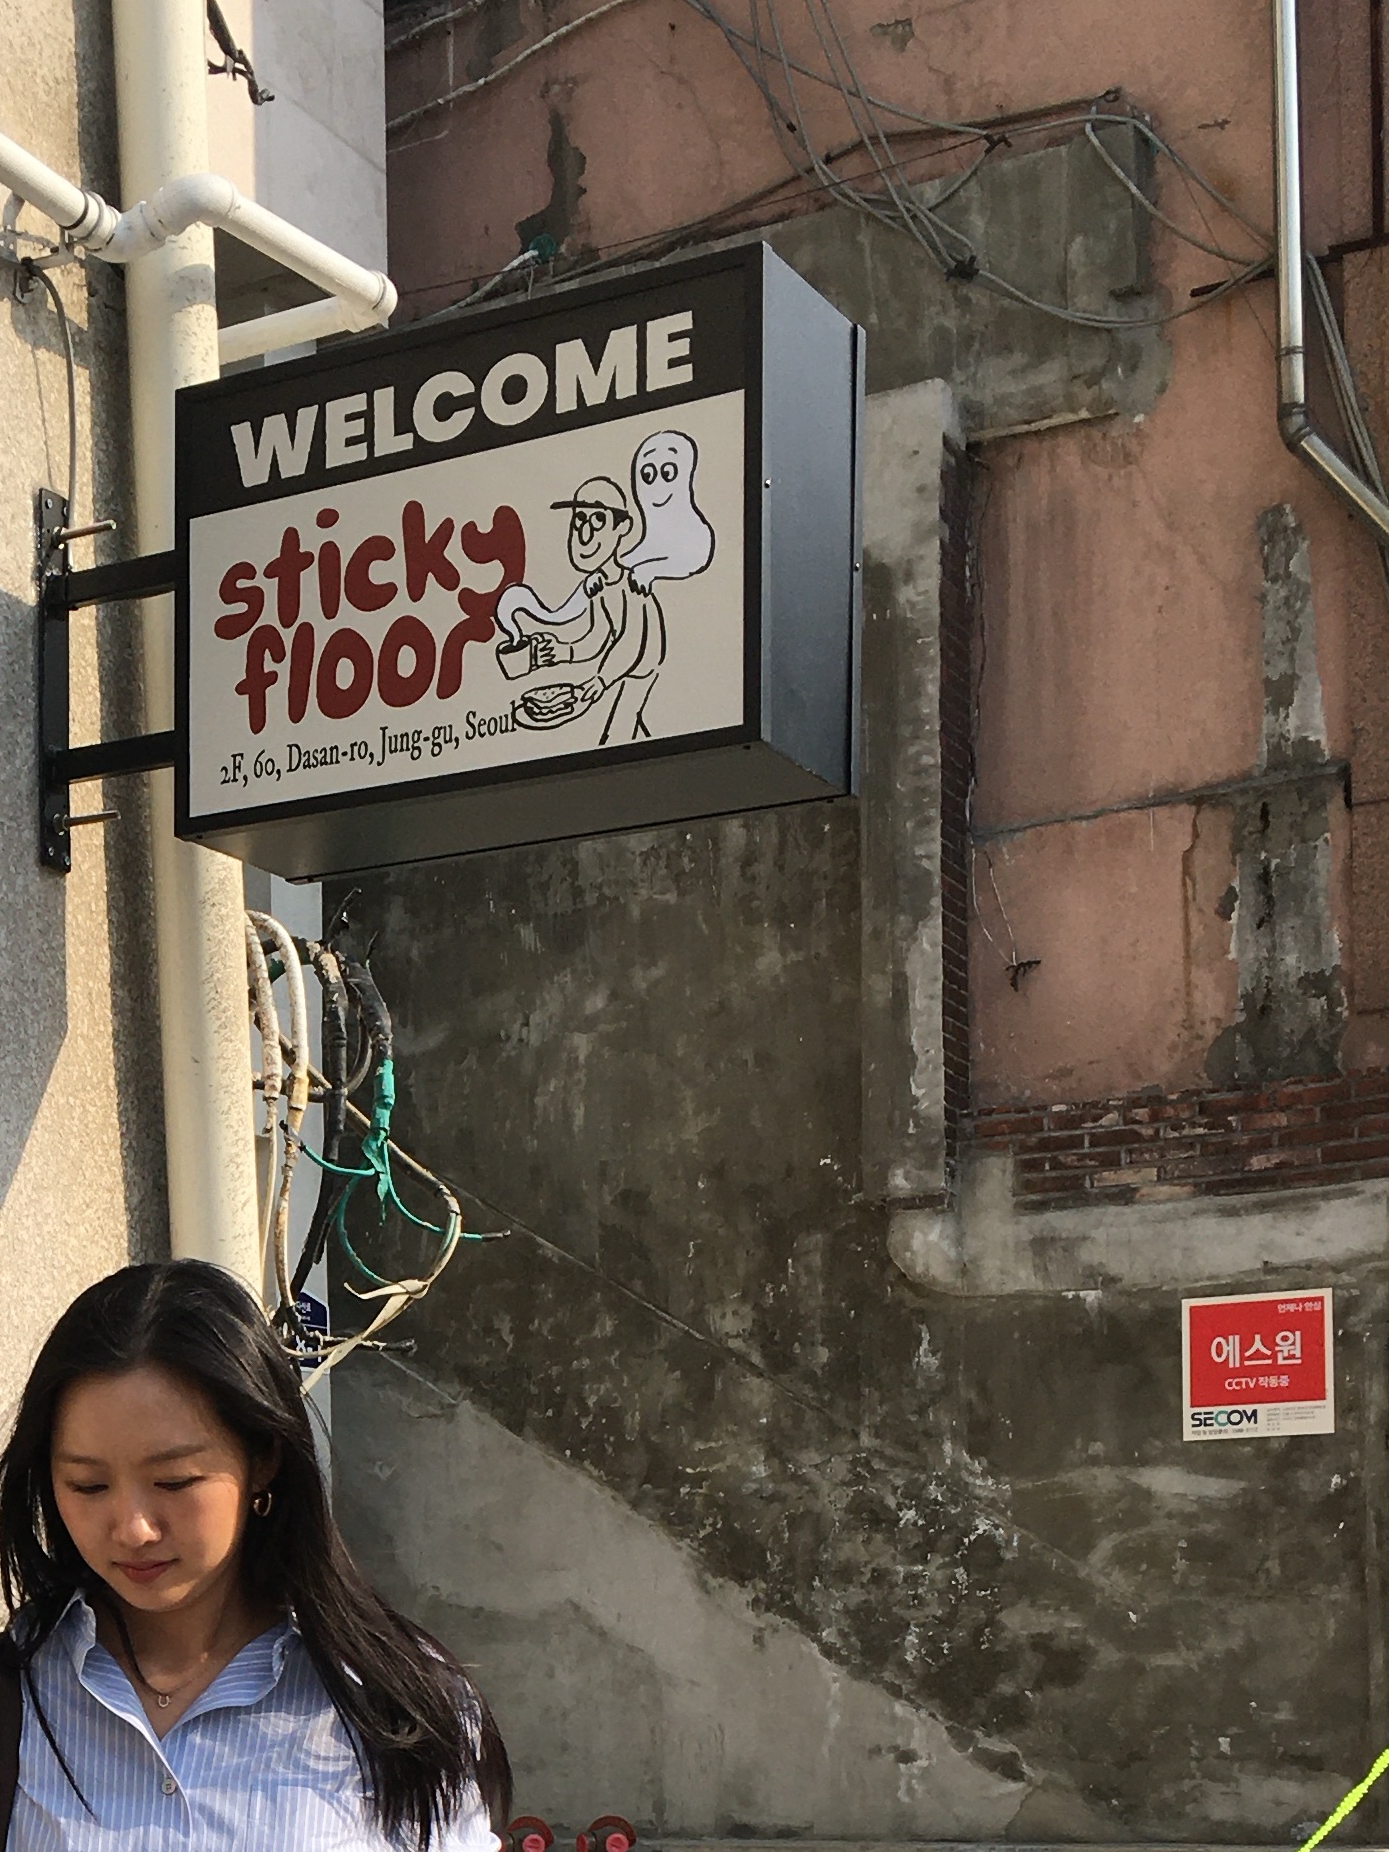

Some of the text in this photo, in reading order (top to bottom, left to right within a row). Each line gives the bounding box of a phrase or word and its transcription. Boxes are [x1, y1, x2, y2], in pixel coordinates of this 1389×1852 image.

[229, 310, 695, 489] WELCOME
[214, 499, 527, 641] sticky
[234, 614, 496, 735] floor
[219, 699, 517, 788] 2F, 60, Dasan-ro, Jung-gu, Seoul
[1210, 1330, 1303, 1369] 에스원
[1224, 1374, 1290, 1390] CCTV 작동중
[1190, 1408, 1259, 1428] SECOM
